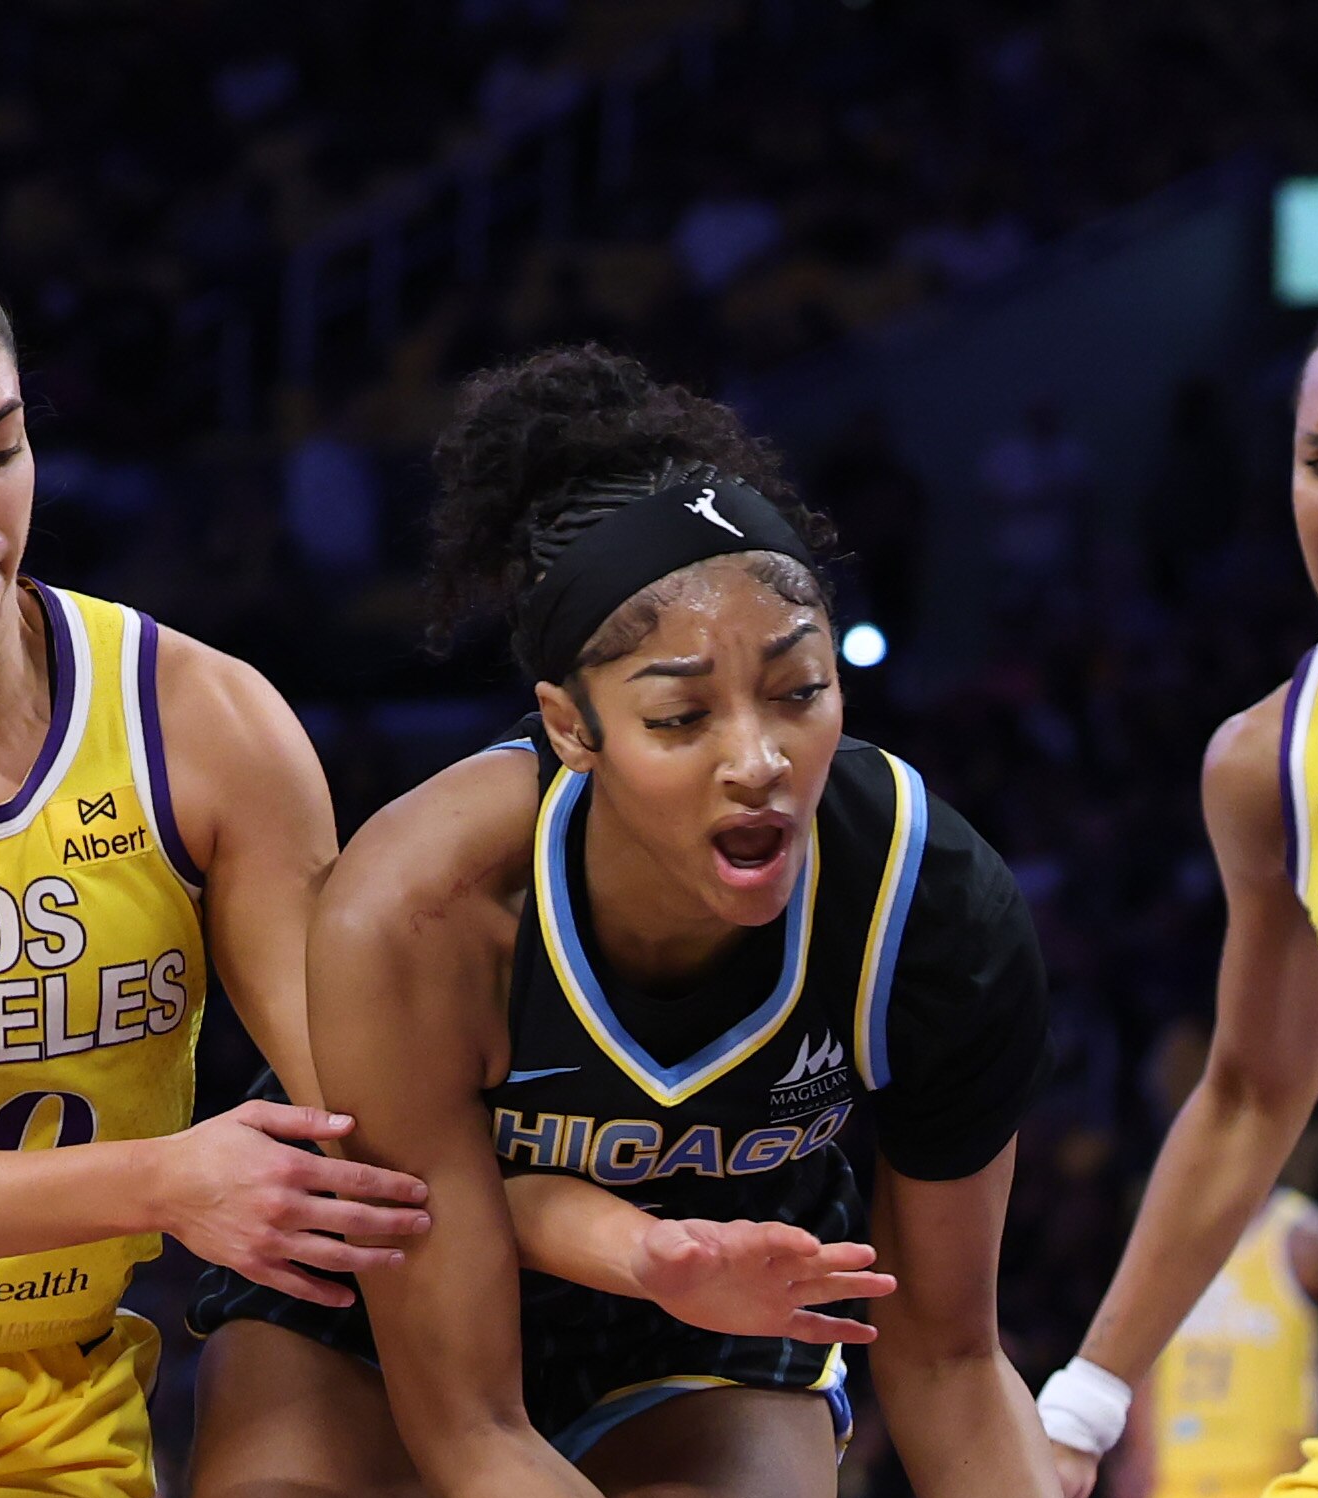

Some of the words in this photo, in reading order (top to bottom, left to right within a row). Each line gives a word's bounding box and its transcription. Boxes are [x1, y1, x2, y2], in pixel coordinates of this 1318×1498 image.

[62, 825, 147, 865] Albert
[769, 1071, 848, 1105] MAGELLAN
[492, 1104, 854, 1185] HICAGO
